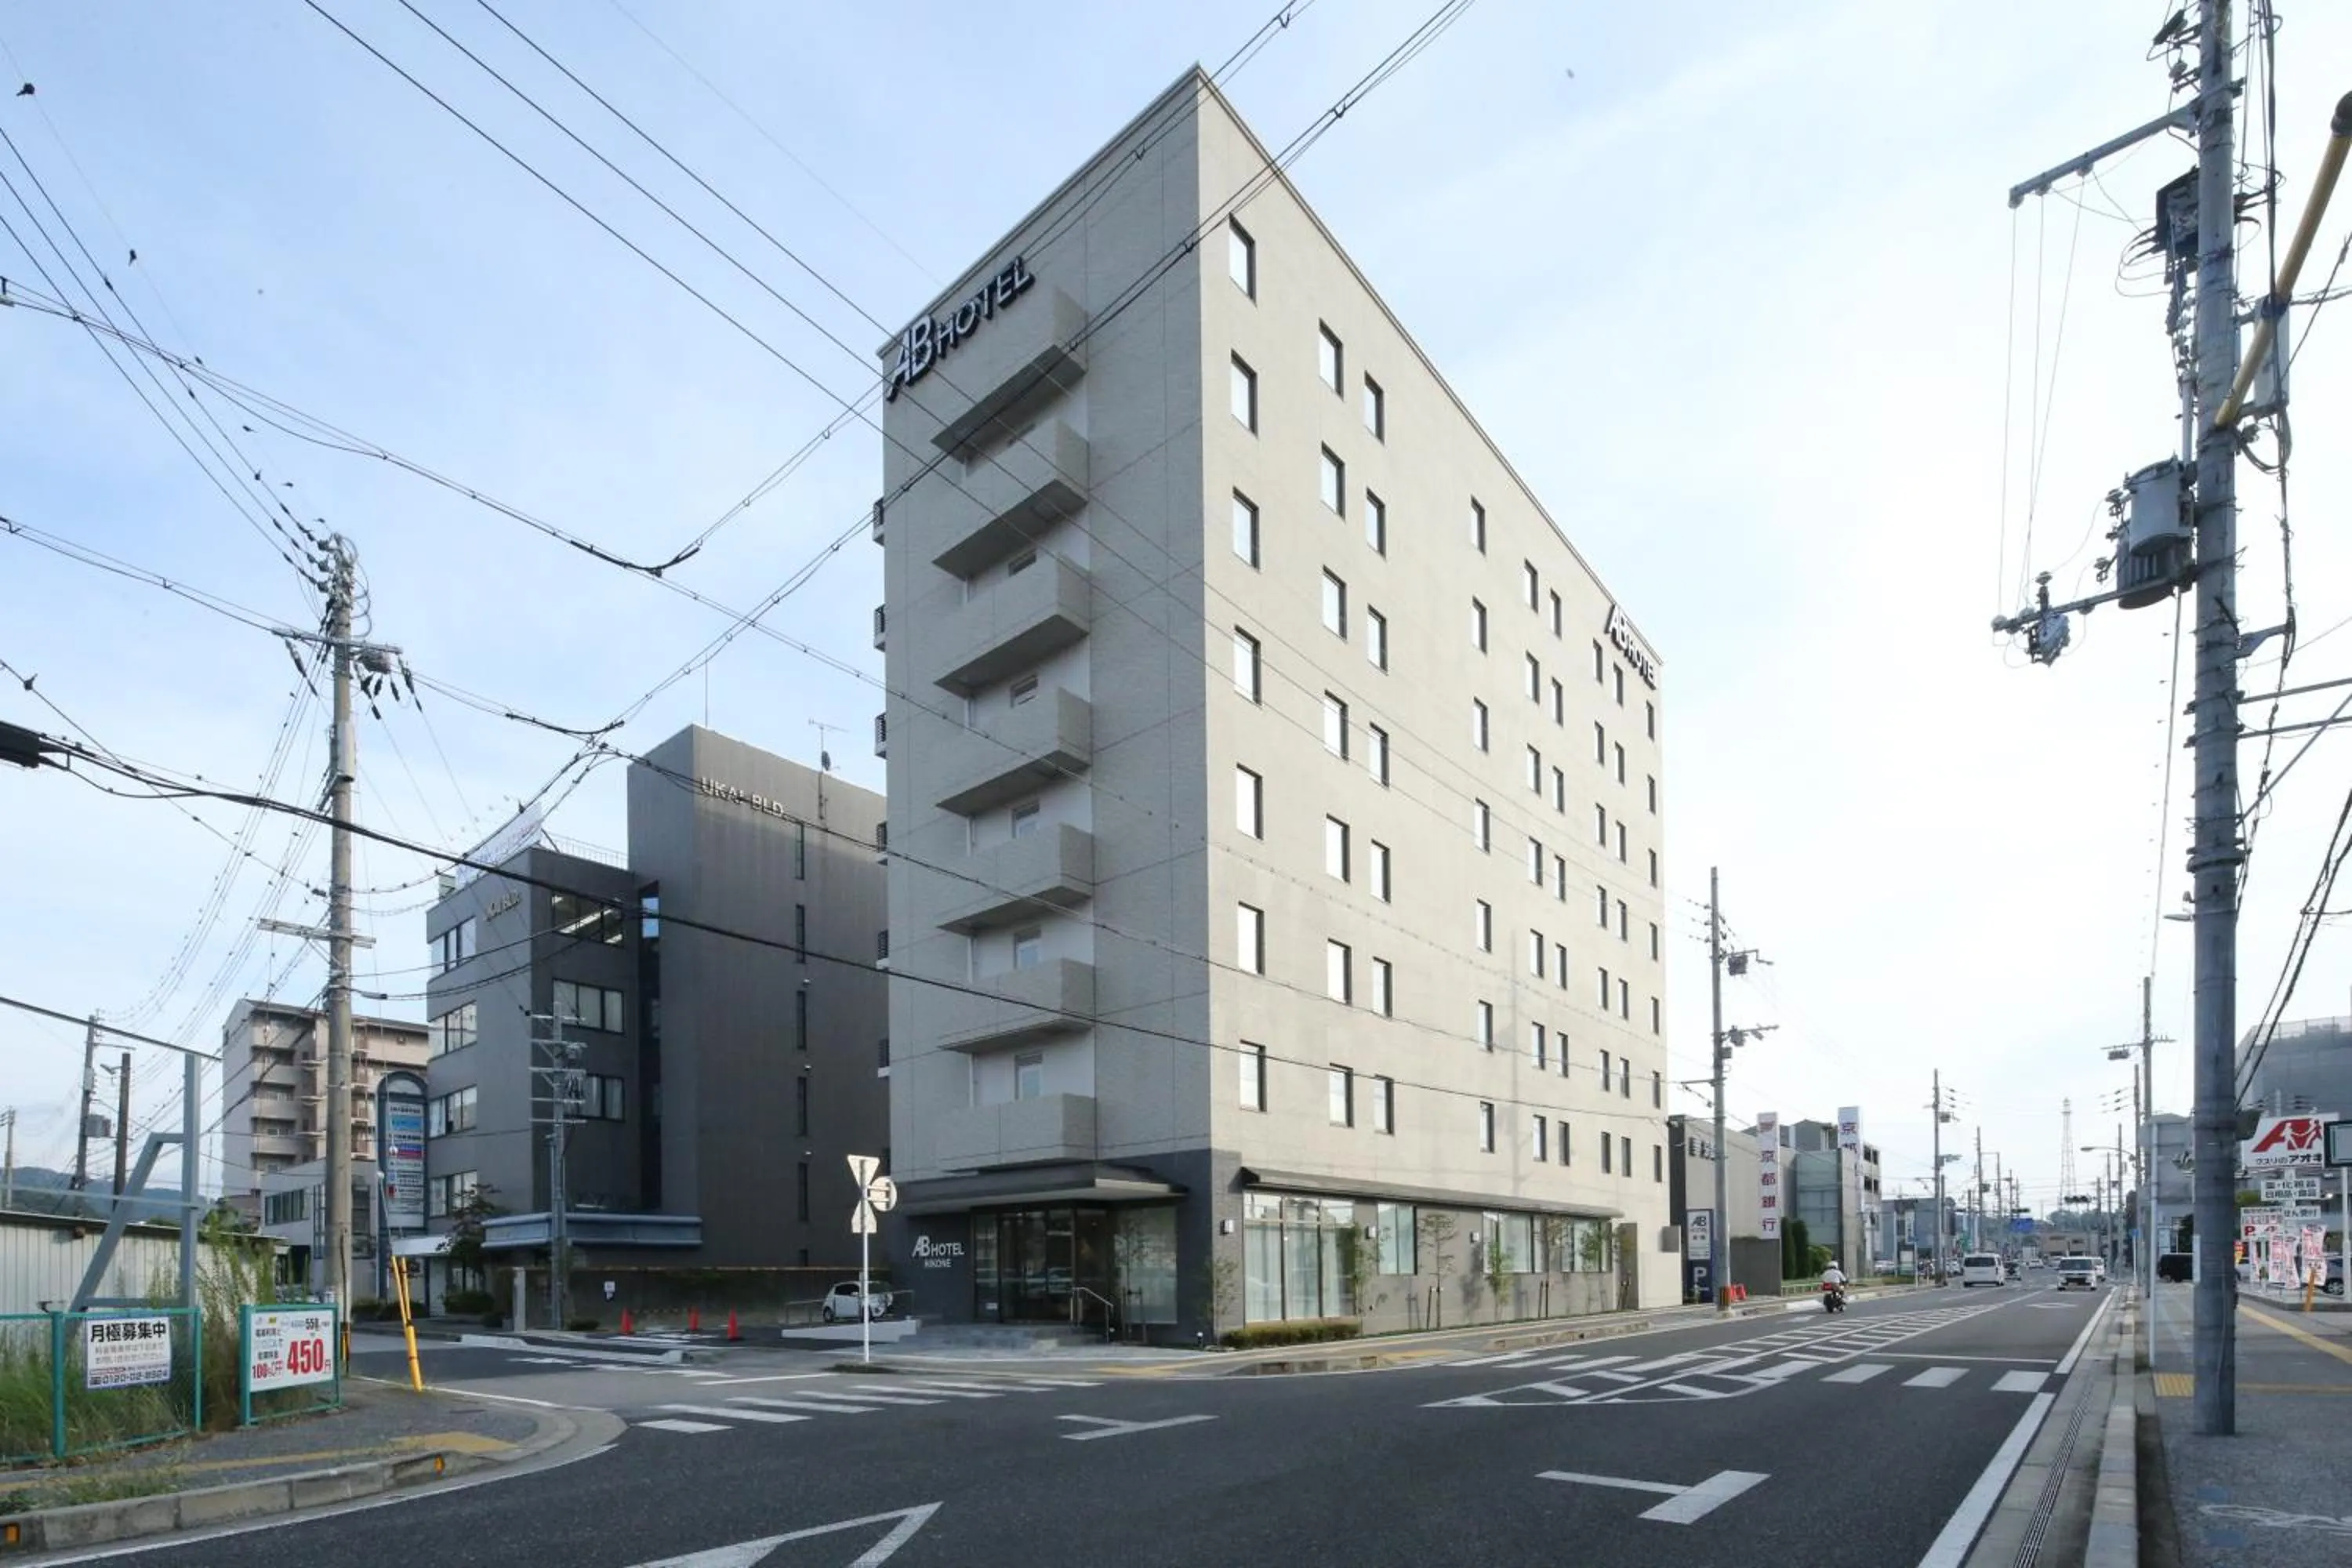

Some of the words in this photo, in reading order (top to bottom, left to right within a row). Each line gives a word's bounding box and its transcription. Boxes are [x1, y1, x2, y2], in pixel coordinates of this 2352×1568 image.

[887, 314, 935, 401] AB
[937, 255, 1035, 359] HOTEL
[1604, 603, 1628, 651] AB
[2256, 1153, 2322, 1165] クスリのアオキ
[1760, 1149, 1777, 1232] 京都銀行
[912, 1235, 931, 1258] AB
[931, 1242, 965, 1257] HOTEL
[90, 1320, 167, 1343] 月極募集中
